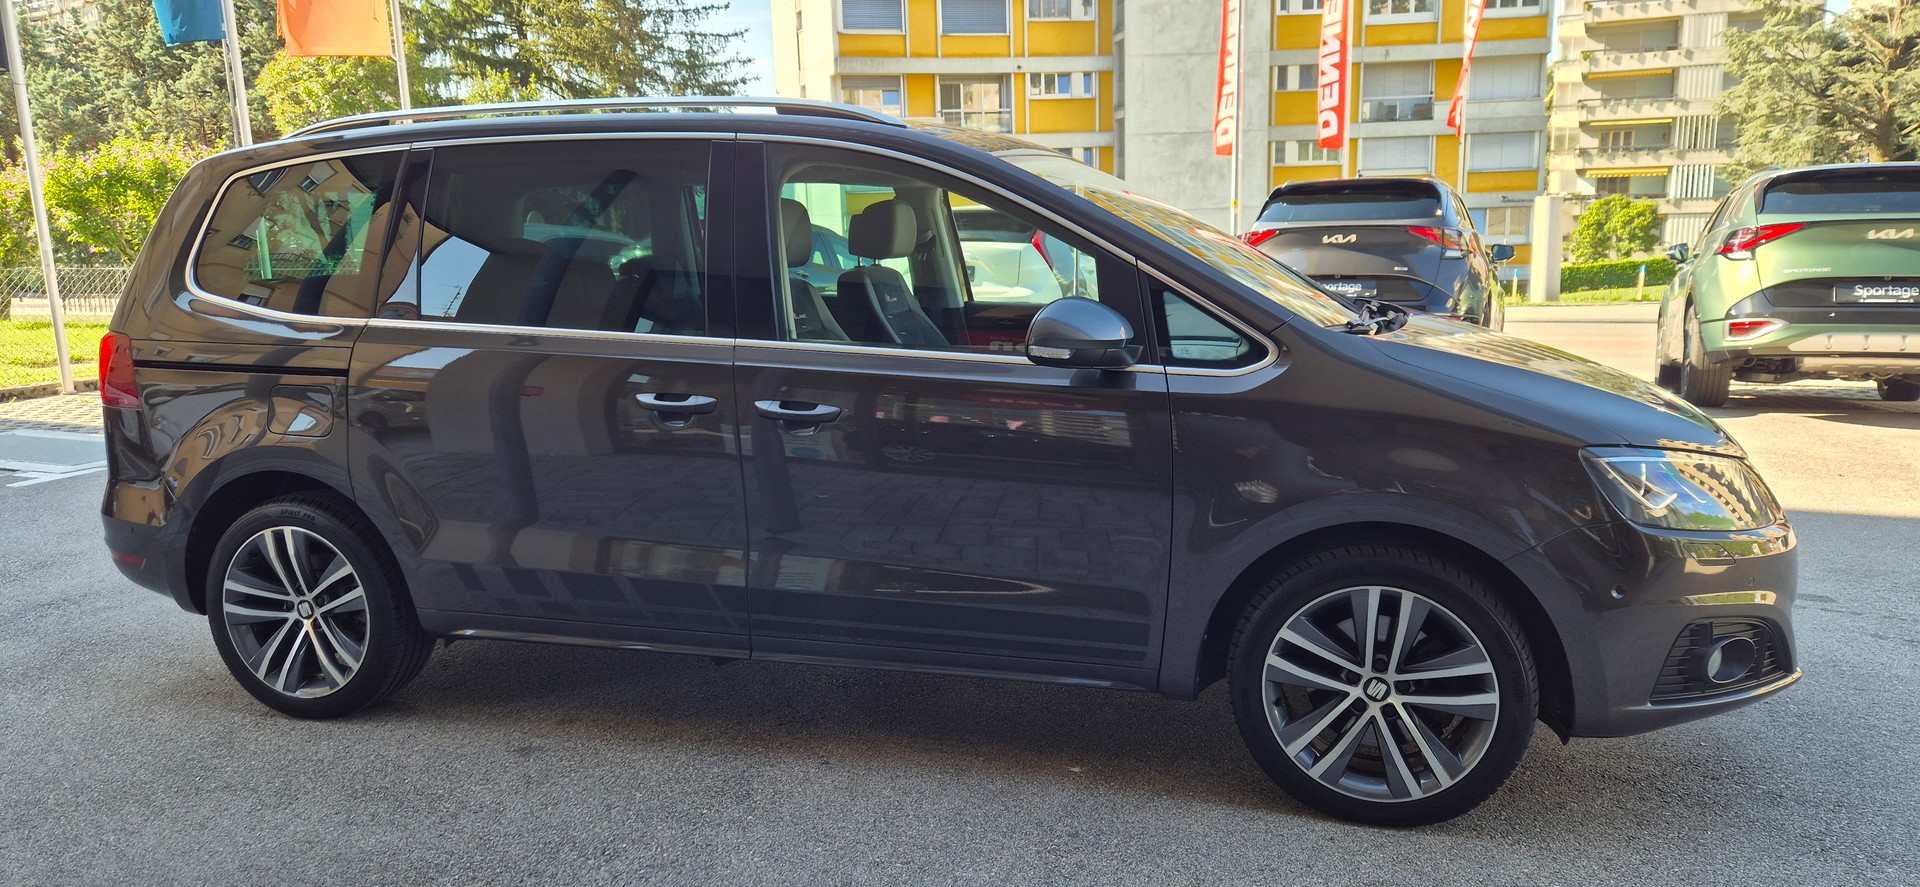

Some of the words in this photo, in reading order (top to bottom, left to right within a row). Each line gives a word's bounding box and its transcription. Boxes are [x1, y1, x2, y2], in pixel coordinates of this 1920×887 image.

[1853, 284, 1920, 298] Sportage
[280, 509, 301, 517] SPIRIT
[303, 512, 316, 521] PRO
